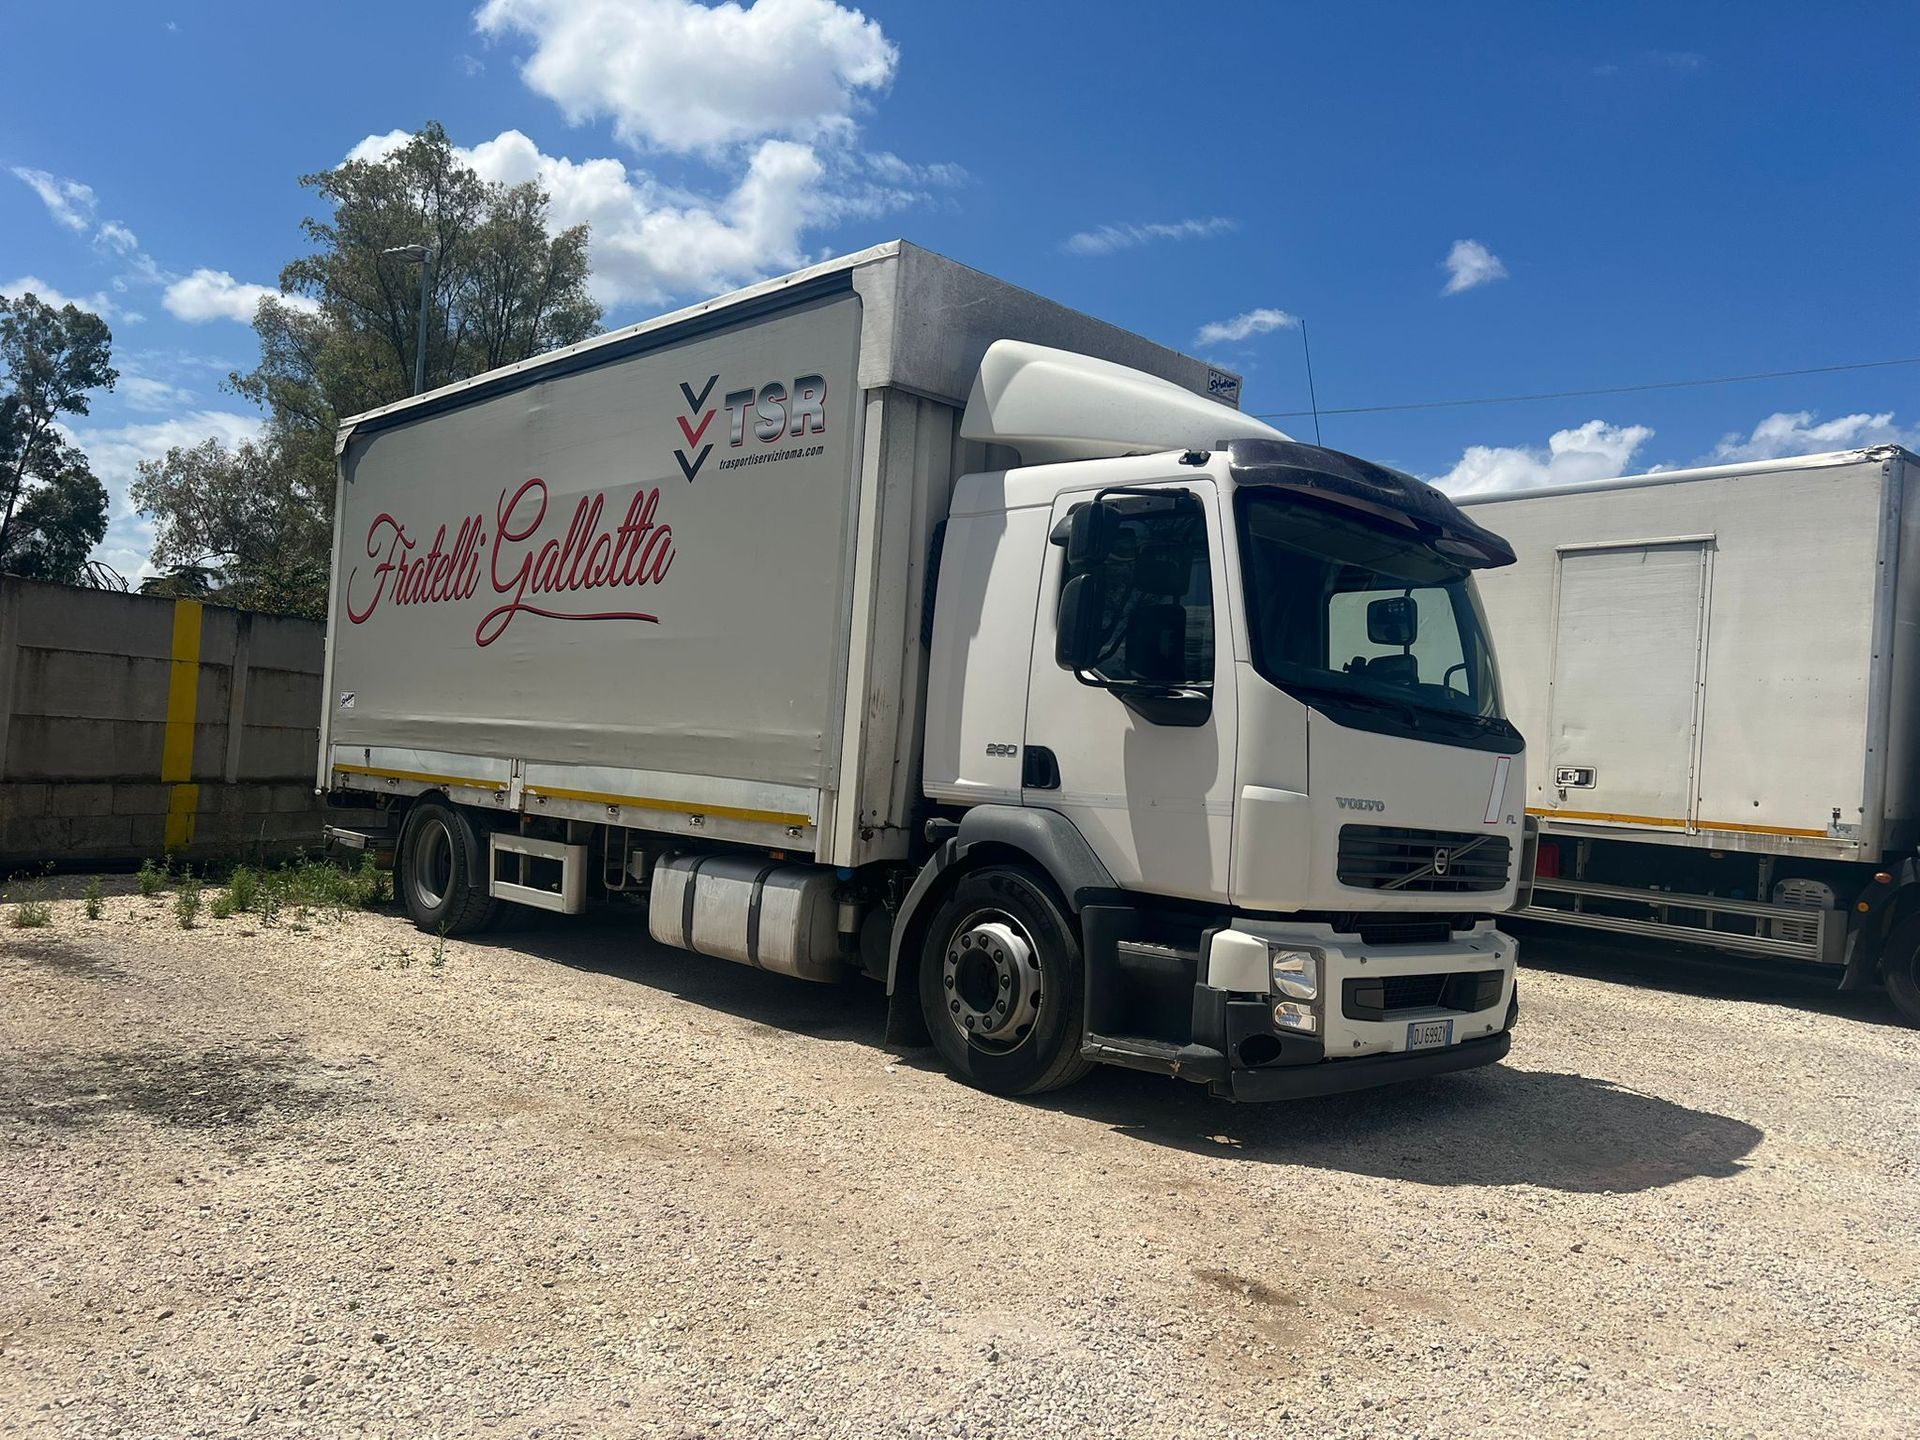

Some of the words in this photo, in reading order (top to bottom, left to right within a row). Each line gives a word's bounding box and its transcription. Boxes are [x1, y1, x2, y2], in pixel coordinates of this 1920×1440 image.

[725, 373, 827, 448] TSR
[719, 445, 825, 470] trasportiserviziroma.com
[347, 513, 487, 624] Fratelli
[476, 478, 677, 647] Gallotta
[1335, 796, 1386, 812] VOLVO
